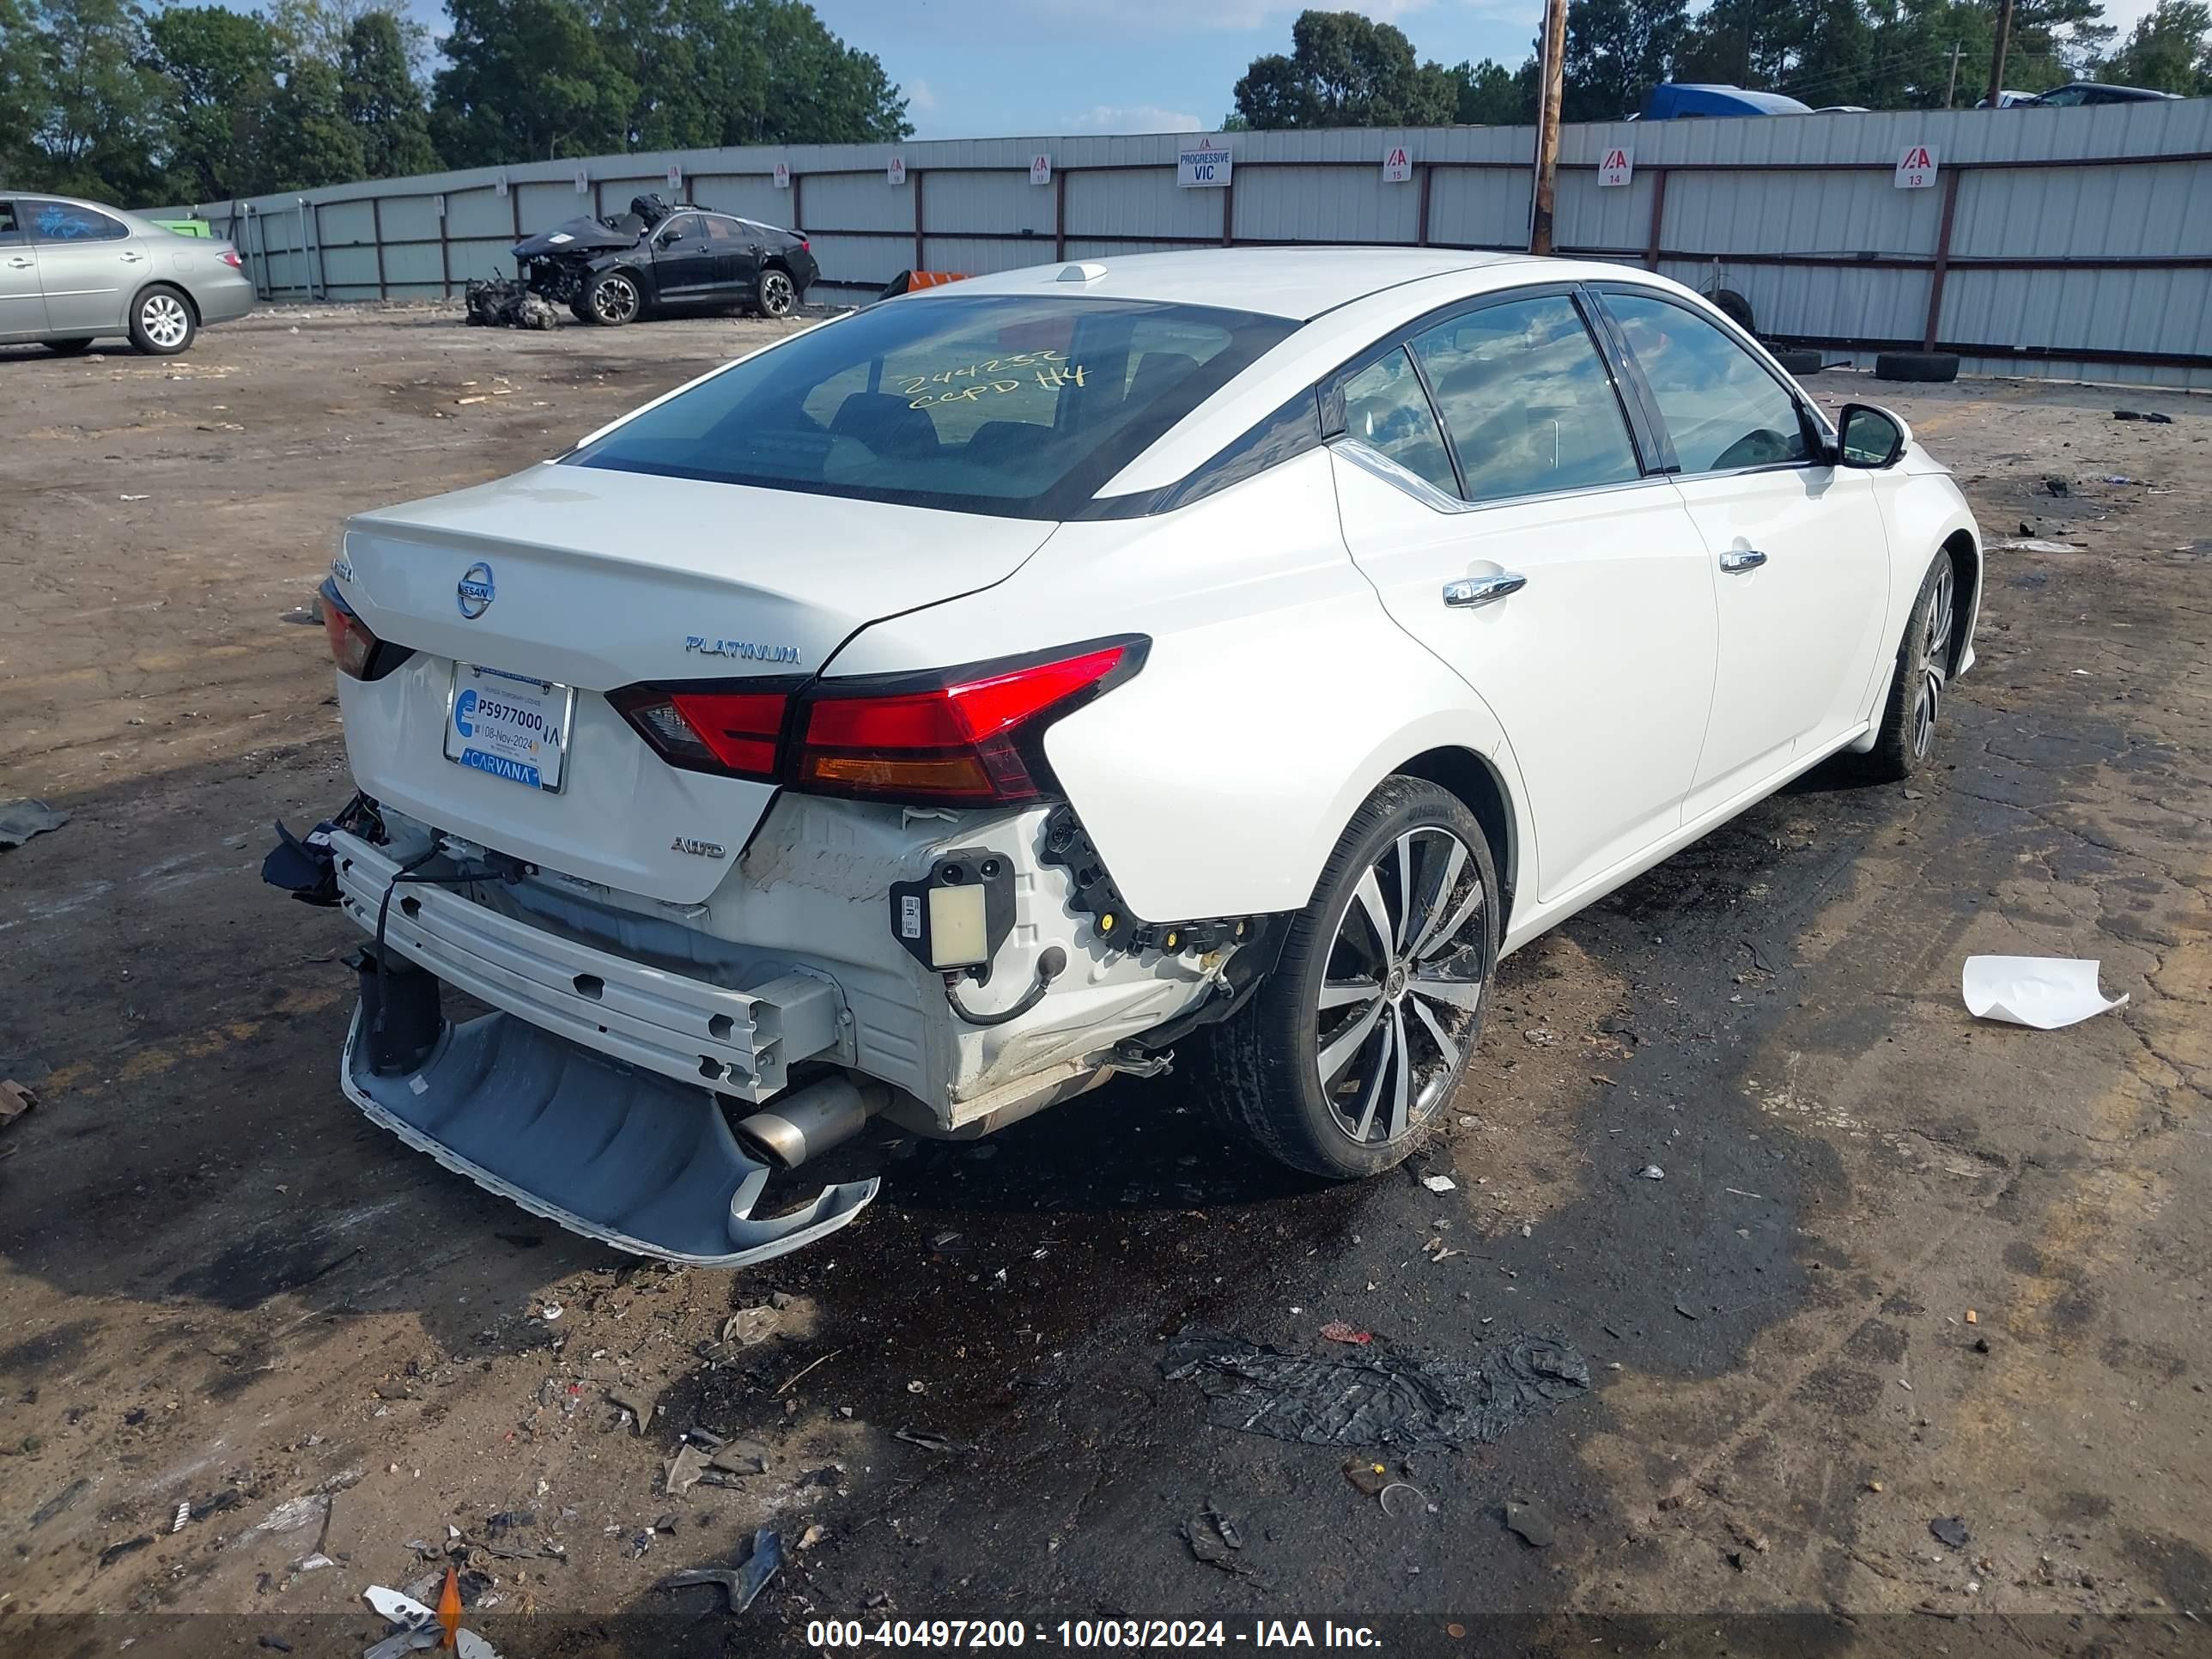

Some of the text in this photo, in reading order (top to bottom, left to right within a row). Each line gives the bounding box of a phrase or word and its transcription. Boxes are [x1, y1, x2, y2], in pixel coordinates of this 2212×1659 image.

[1180, 152, 1230, 165] PROGRESSIVE
[1194, 165, 1214, 180] VIC
[1610, 174, 1620, 184] 14
[1909, 174, 1923, 185] 13
[686, 635, 802, 665] PLATINUM
[478, 699, 543, 731] P5977000
[485, 726, 532, 751] 08-Nov-2024
[471, 751, 531, 783] CARVANA
[671, 836, 726, 859] AWD
